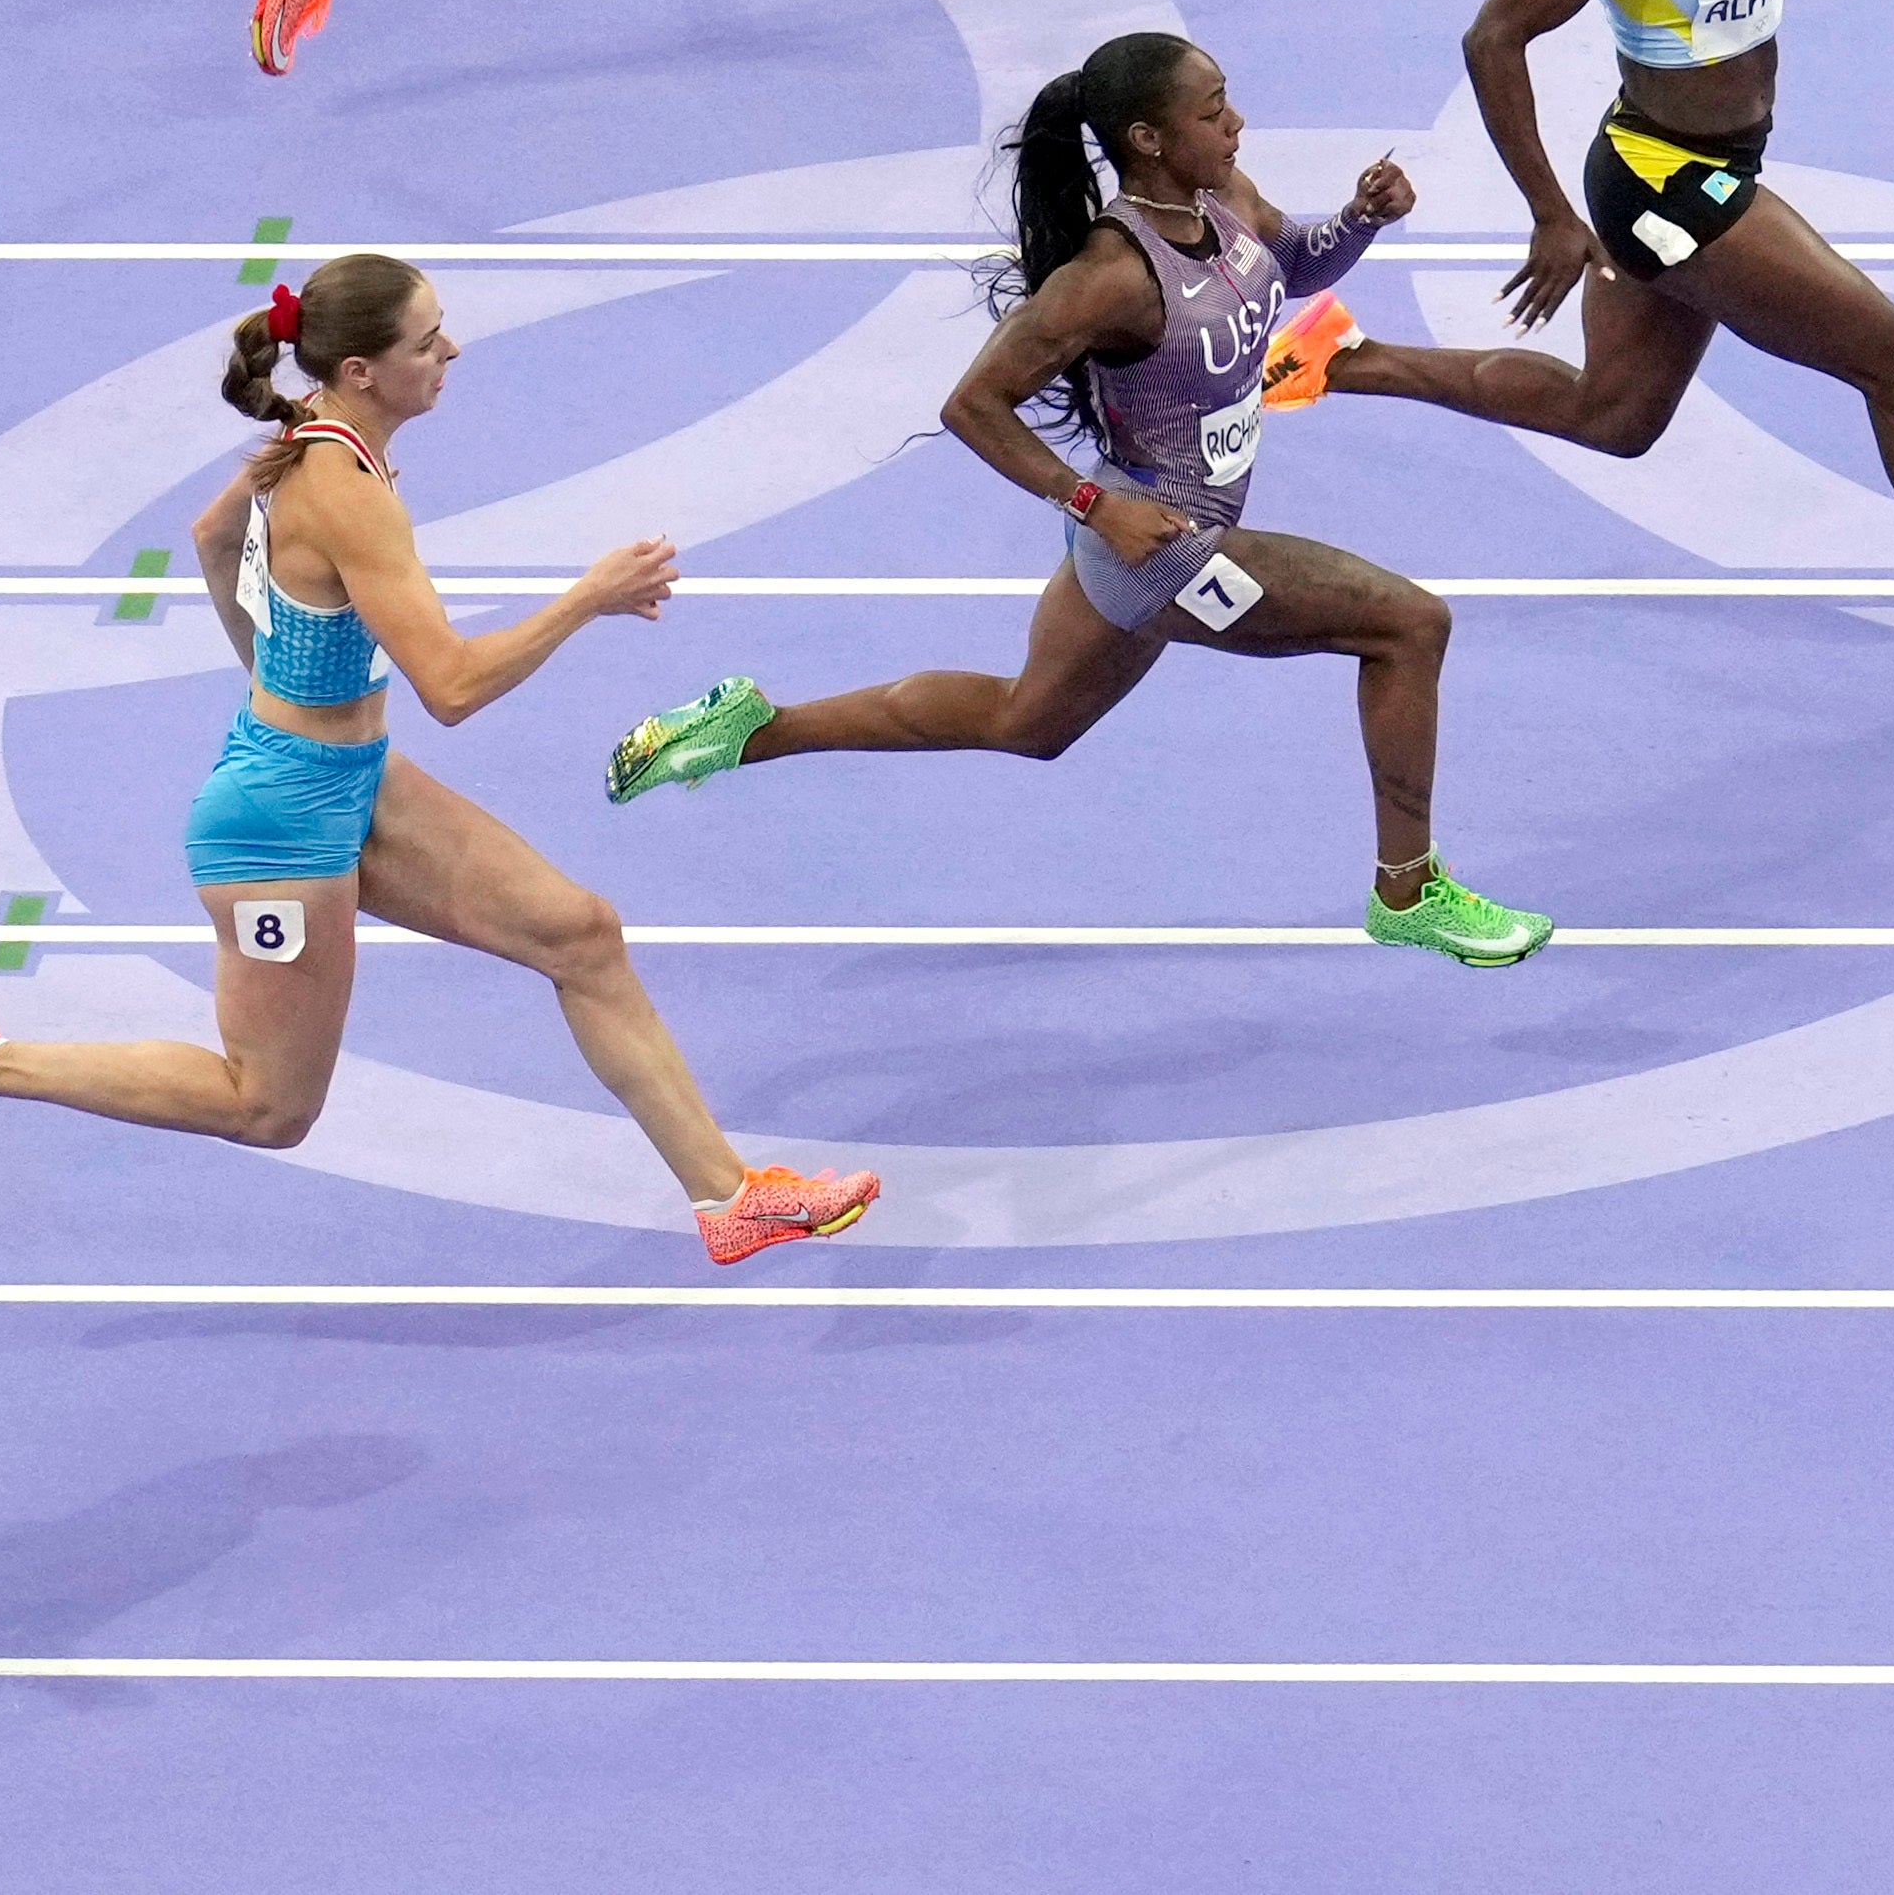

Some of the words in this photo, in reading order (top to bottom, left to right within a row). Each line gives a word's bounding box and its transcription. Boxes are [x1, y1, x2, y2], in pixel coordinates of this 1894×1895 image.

[1309, 212, 1351, 257] USA
[1200, 280, 1286, 375] USA
[1197, 575, 1236, 609] 7
[254, 913, 285, 950] 8
